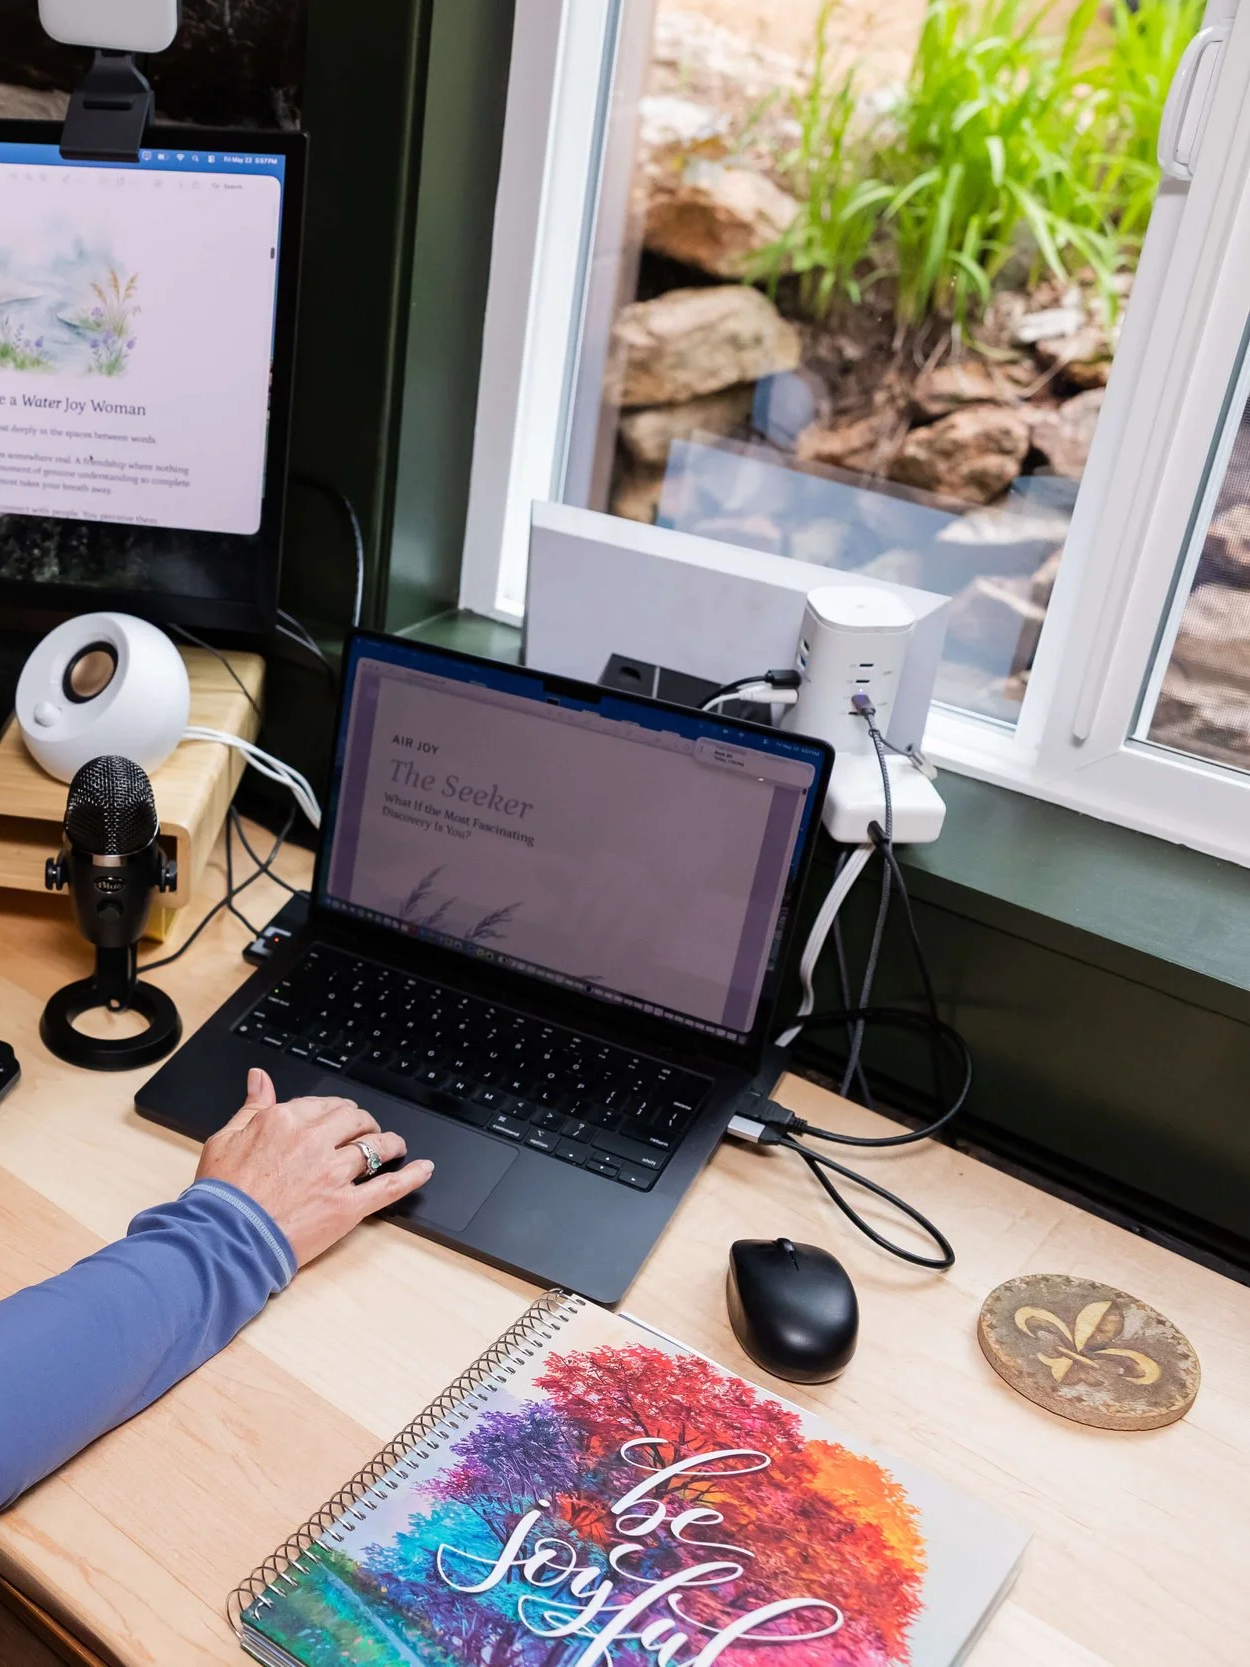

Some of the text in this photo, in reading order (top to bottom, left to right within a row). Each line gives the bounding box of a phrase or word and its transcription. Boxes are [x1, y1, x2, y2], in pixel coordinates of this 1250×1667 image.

[9, 396, 18, 406] a
[22, 393, 62, 409] Water
[63, 397, 87, 415] Joy
[91, 399, 146, 416] Woman
[11, 424, 37, 435] deeply
[50, 428, 64, 437] the
[65, 430, 92, 440] spaces
[94, 429, 128, 442] between
[7, 452, 53, 463] somewhere
[75, 457, 81, 465] A
[83, 456, 127, 471] friendship
[128, 461, 153, 471] where
[155, 463, 190, 476] nothing
[33, 466, 42, 474] of
[77, 470, 139, 485] understanding
[151, 477, 191, 488] complete
[391, 734, 440, 756] AIR JOY
[389, 758, 535, 820] The Seeker
[381, 805, 473, 842] Discovery Is You?
[383, 791, 536, 848] What If the Most Fascinating
[529, 1138, 549, 1149] option
[649, 1137, 670, 1148] return
[641, 1157, 657, 1167] shift
[610, 1437, 772, 1558] be
[436, 1499, 845, 1667] joyful
